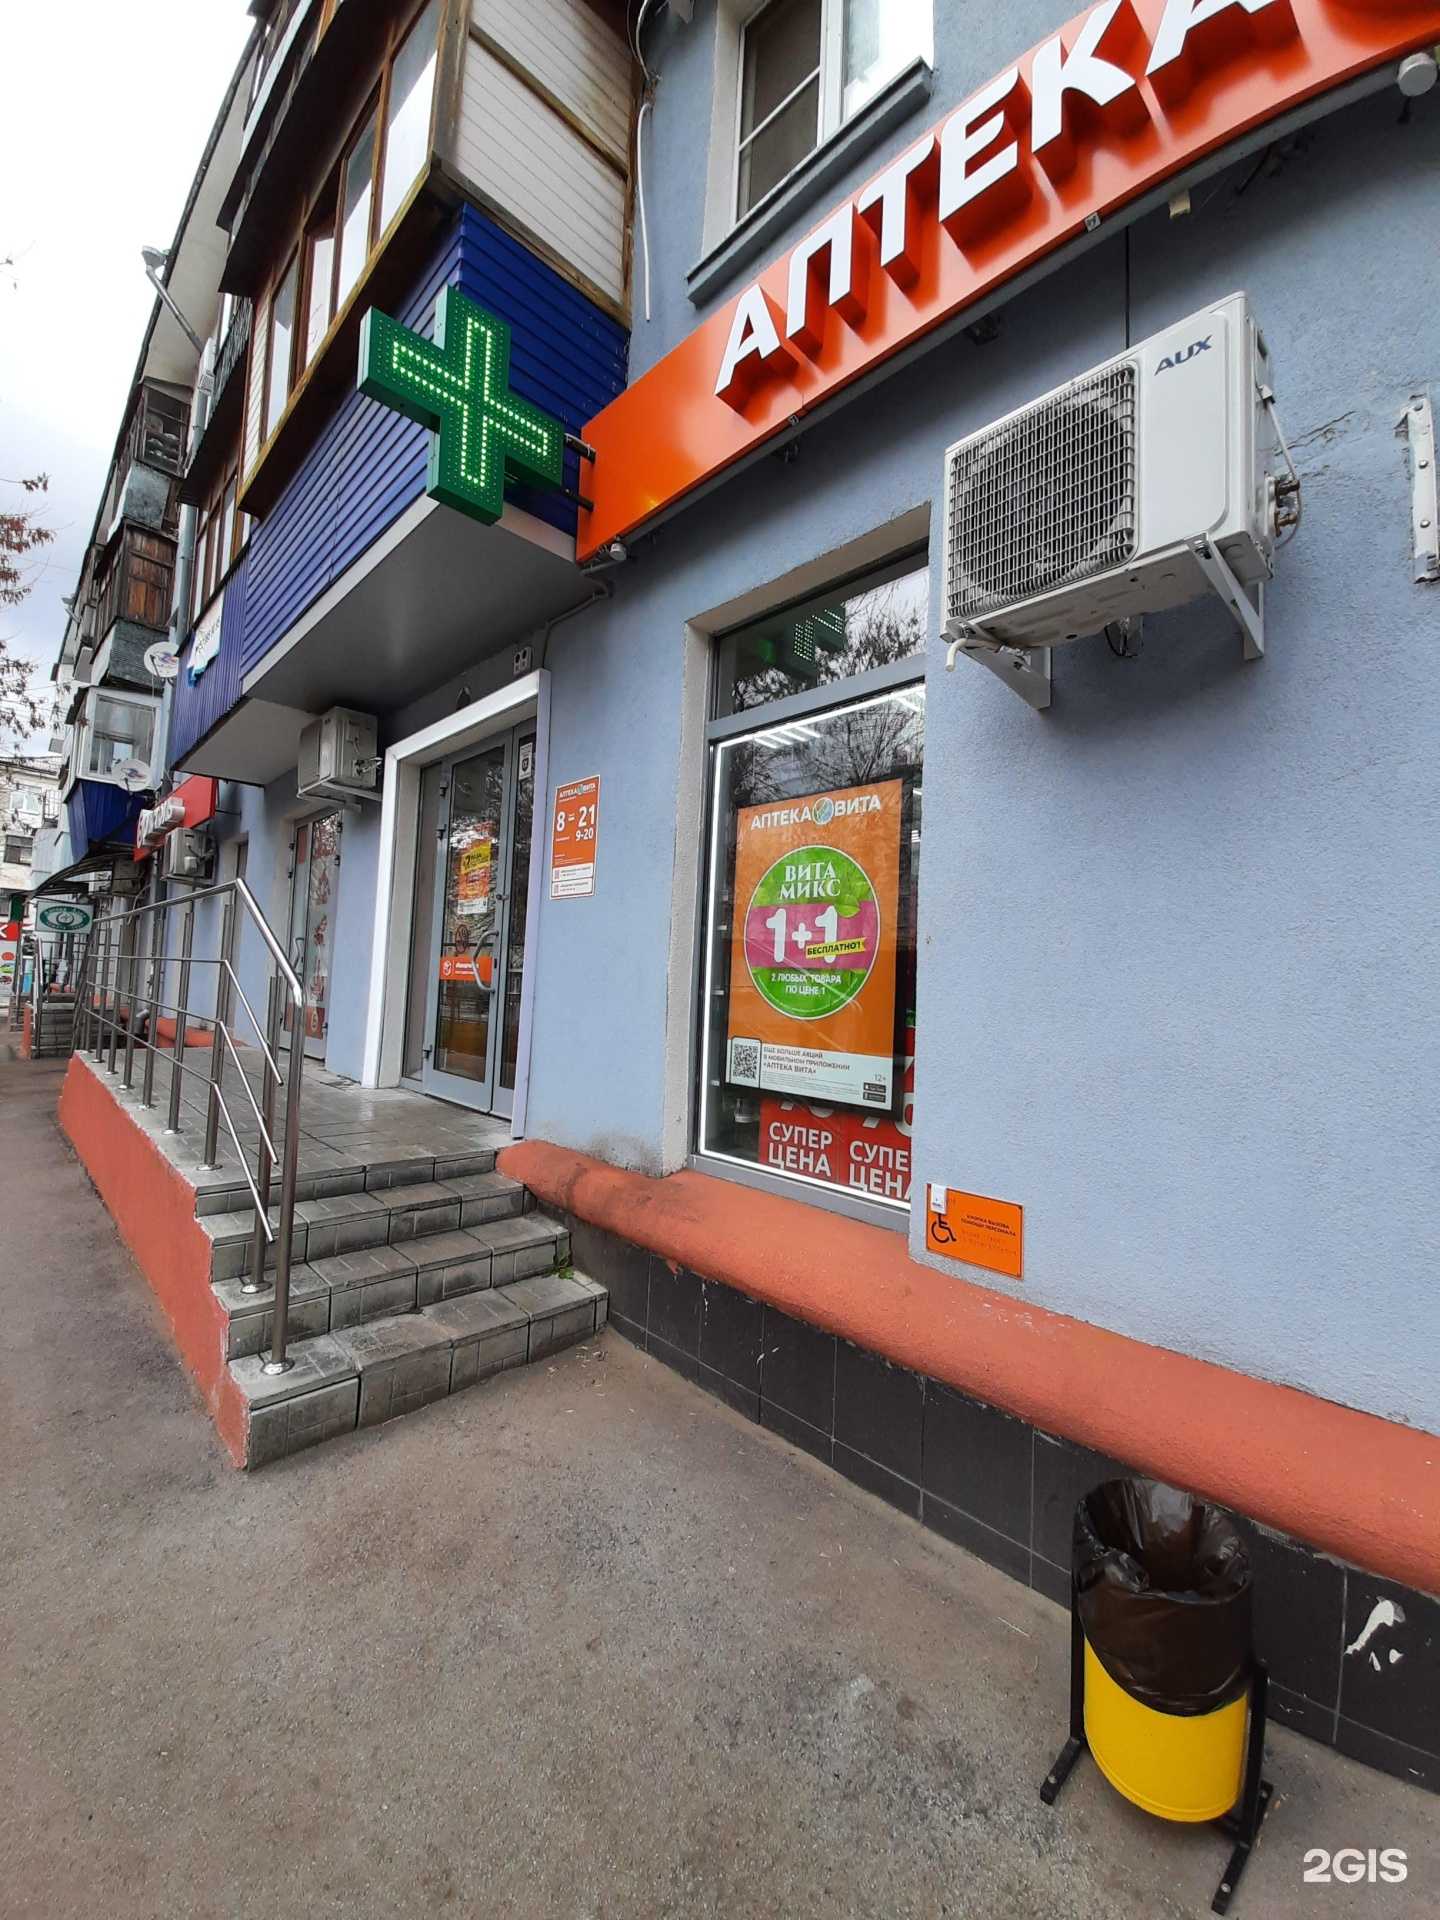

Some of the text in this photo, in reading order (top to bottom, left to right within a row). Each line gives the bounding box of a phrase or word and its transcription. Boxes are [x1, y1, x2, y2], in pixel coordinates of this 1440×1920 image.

[1154, 334, 1213, 377] AUX
[556, 811, 566, 832] 8
[578, 804, 595, 828] 21
[751, 795, 881, 830] АПТЕКА ВИТА
[785, 861, 837, 882] ВИТА
[780, 878, 841, 900] МИКС
[785, 985, 798, 994] ПО
[799, 985, 819, 996] ЦЕНЕ
[810, 974, 842, 985] ТОВАРА
[768, 1121, 833, 1151] СУПЕР
[768, 1142, 832, 1177] ЦЕНА
[849, 1140, 911, 1172] СУПЕ
